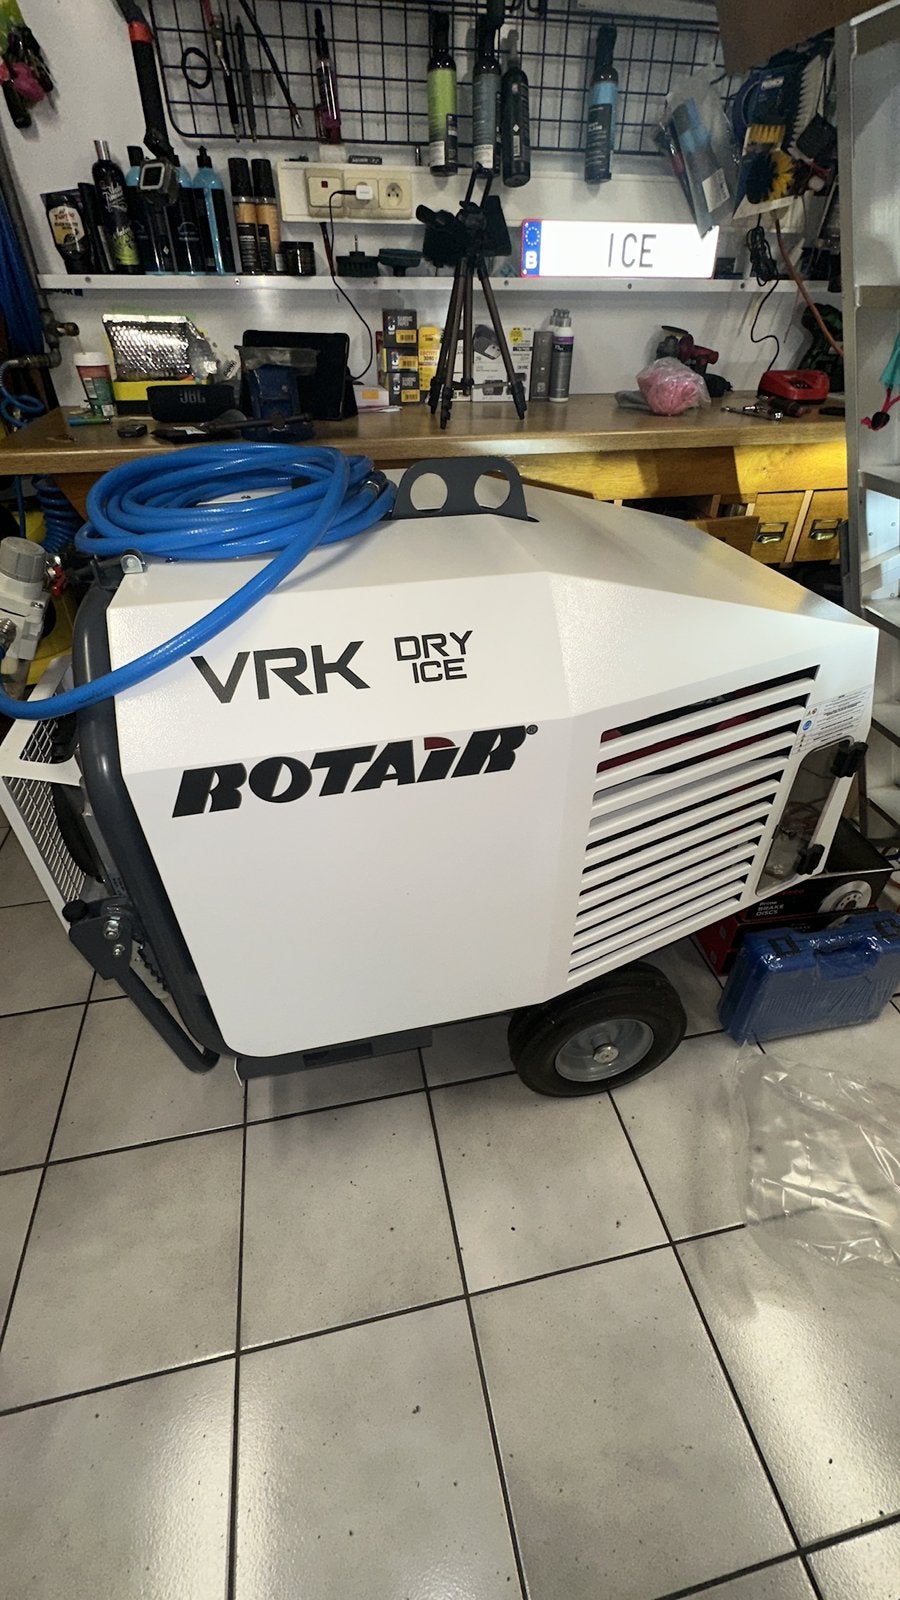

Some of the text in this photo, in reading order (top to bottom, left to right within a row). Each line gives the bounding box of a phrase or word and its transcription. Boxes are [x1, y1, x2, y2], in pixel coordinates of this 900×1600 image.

[525, 250, 538, 270] B
[608, 233, 657, 268] ICE
[180, 390, 206, 404] JBL
[394, 630, 473, 662] DRY
[190, 640, 371, 704] VRK
[411, 657, 468, 684] ICE
[171, 724, 527, 818] ROTAIR
[756, 909, 778, 917] DISCS
[758, 903, 785, 912] BRAKE
